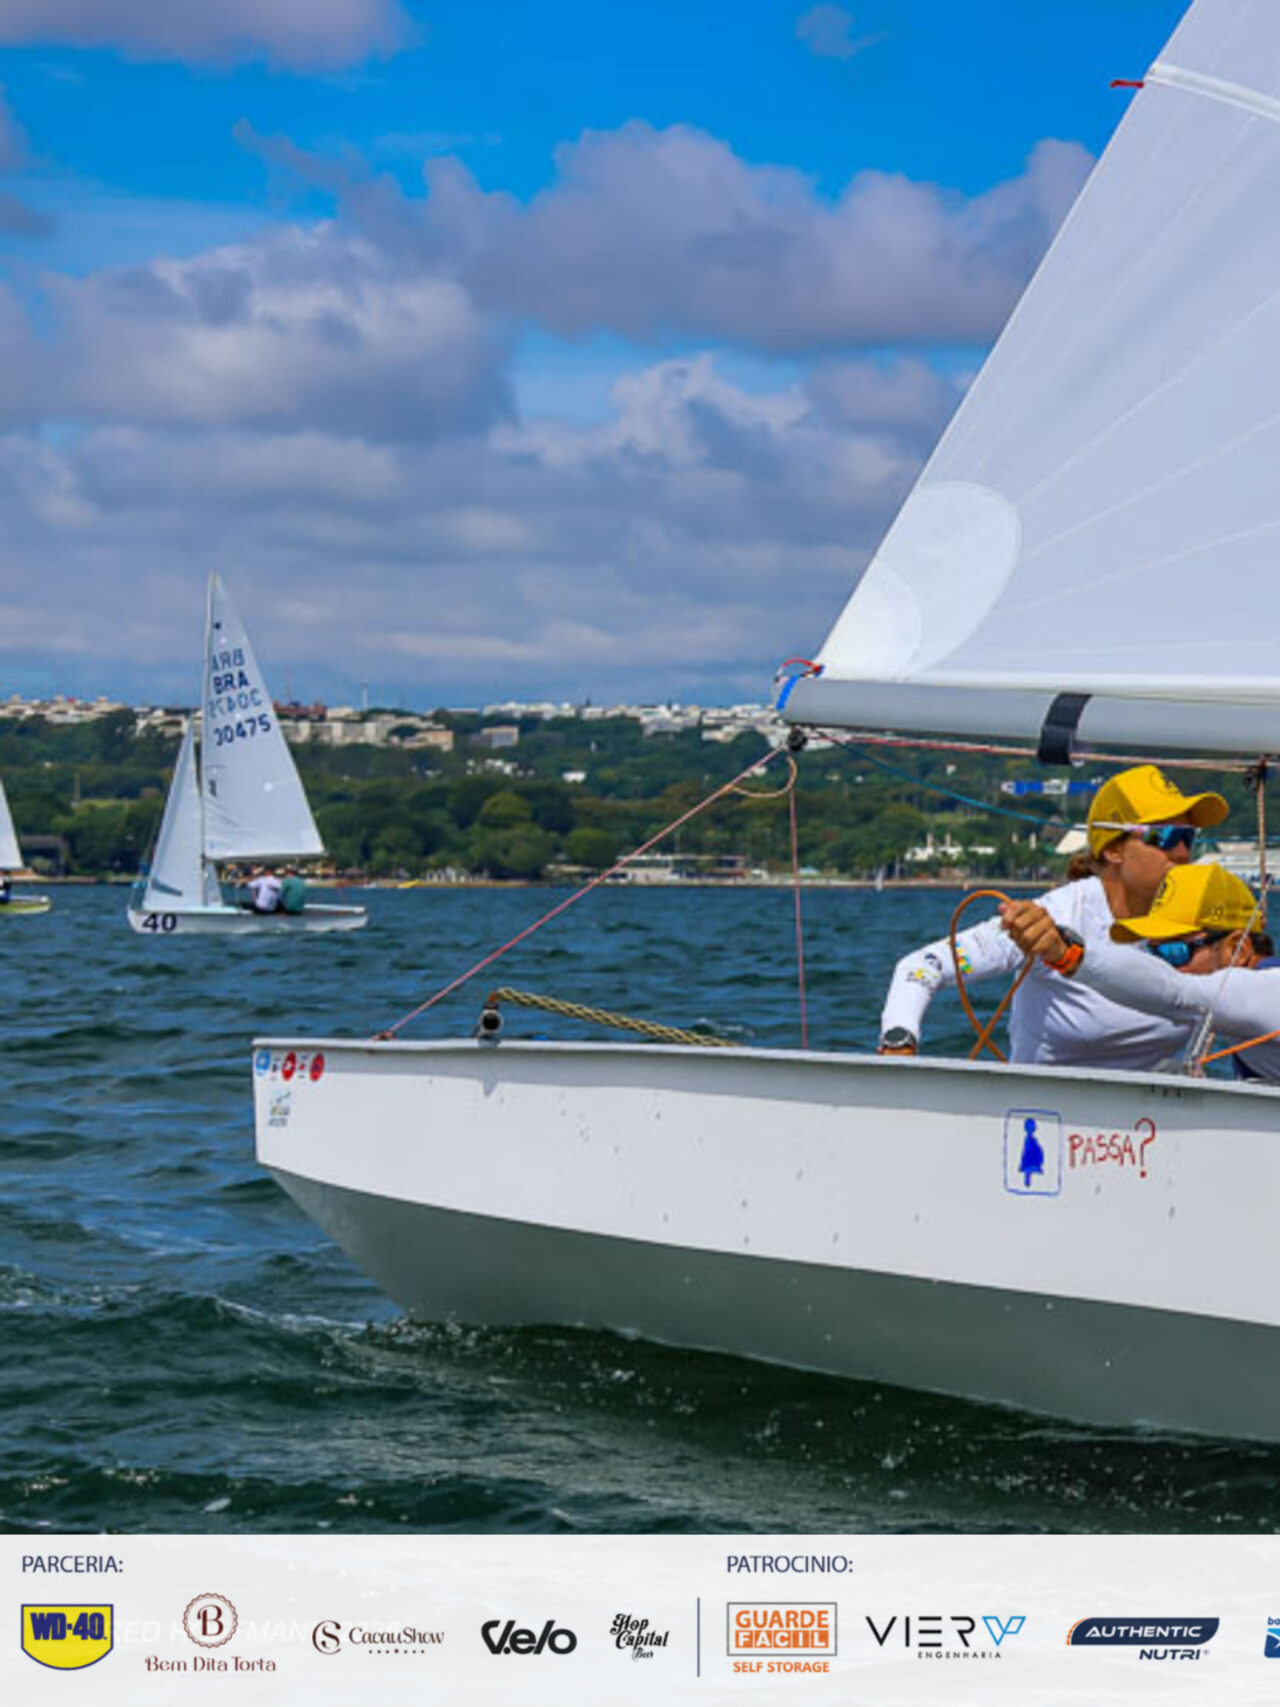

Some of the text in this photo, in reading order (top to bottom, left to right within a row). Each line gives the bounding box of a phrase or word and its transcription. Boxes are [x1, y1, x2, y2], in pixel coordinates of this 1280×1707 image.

[213, 671, 250, 695] BRA
[142, 912, 177, 932] 40
[1068, 1117, 1156, 1179] PASSA?
